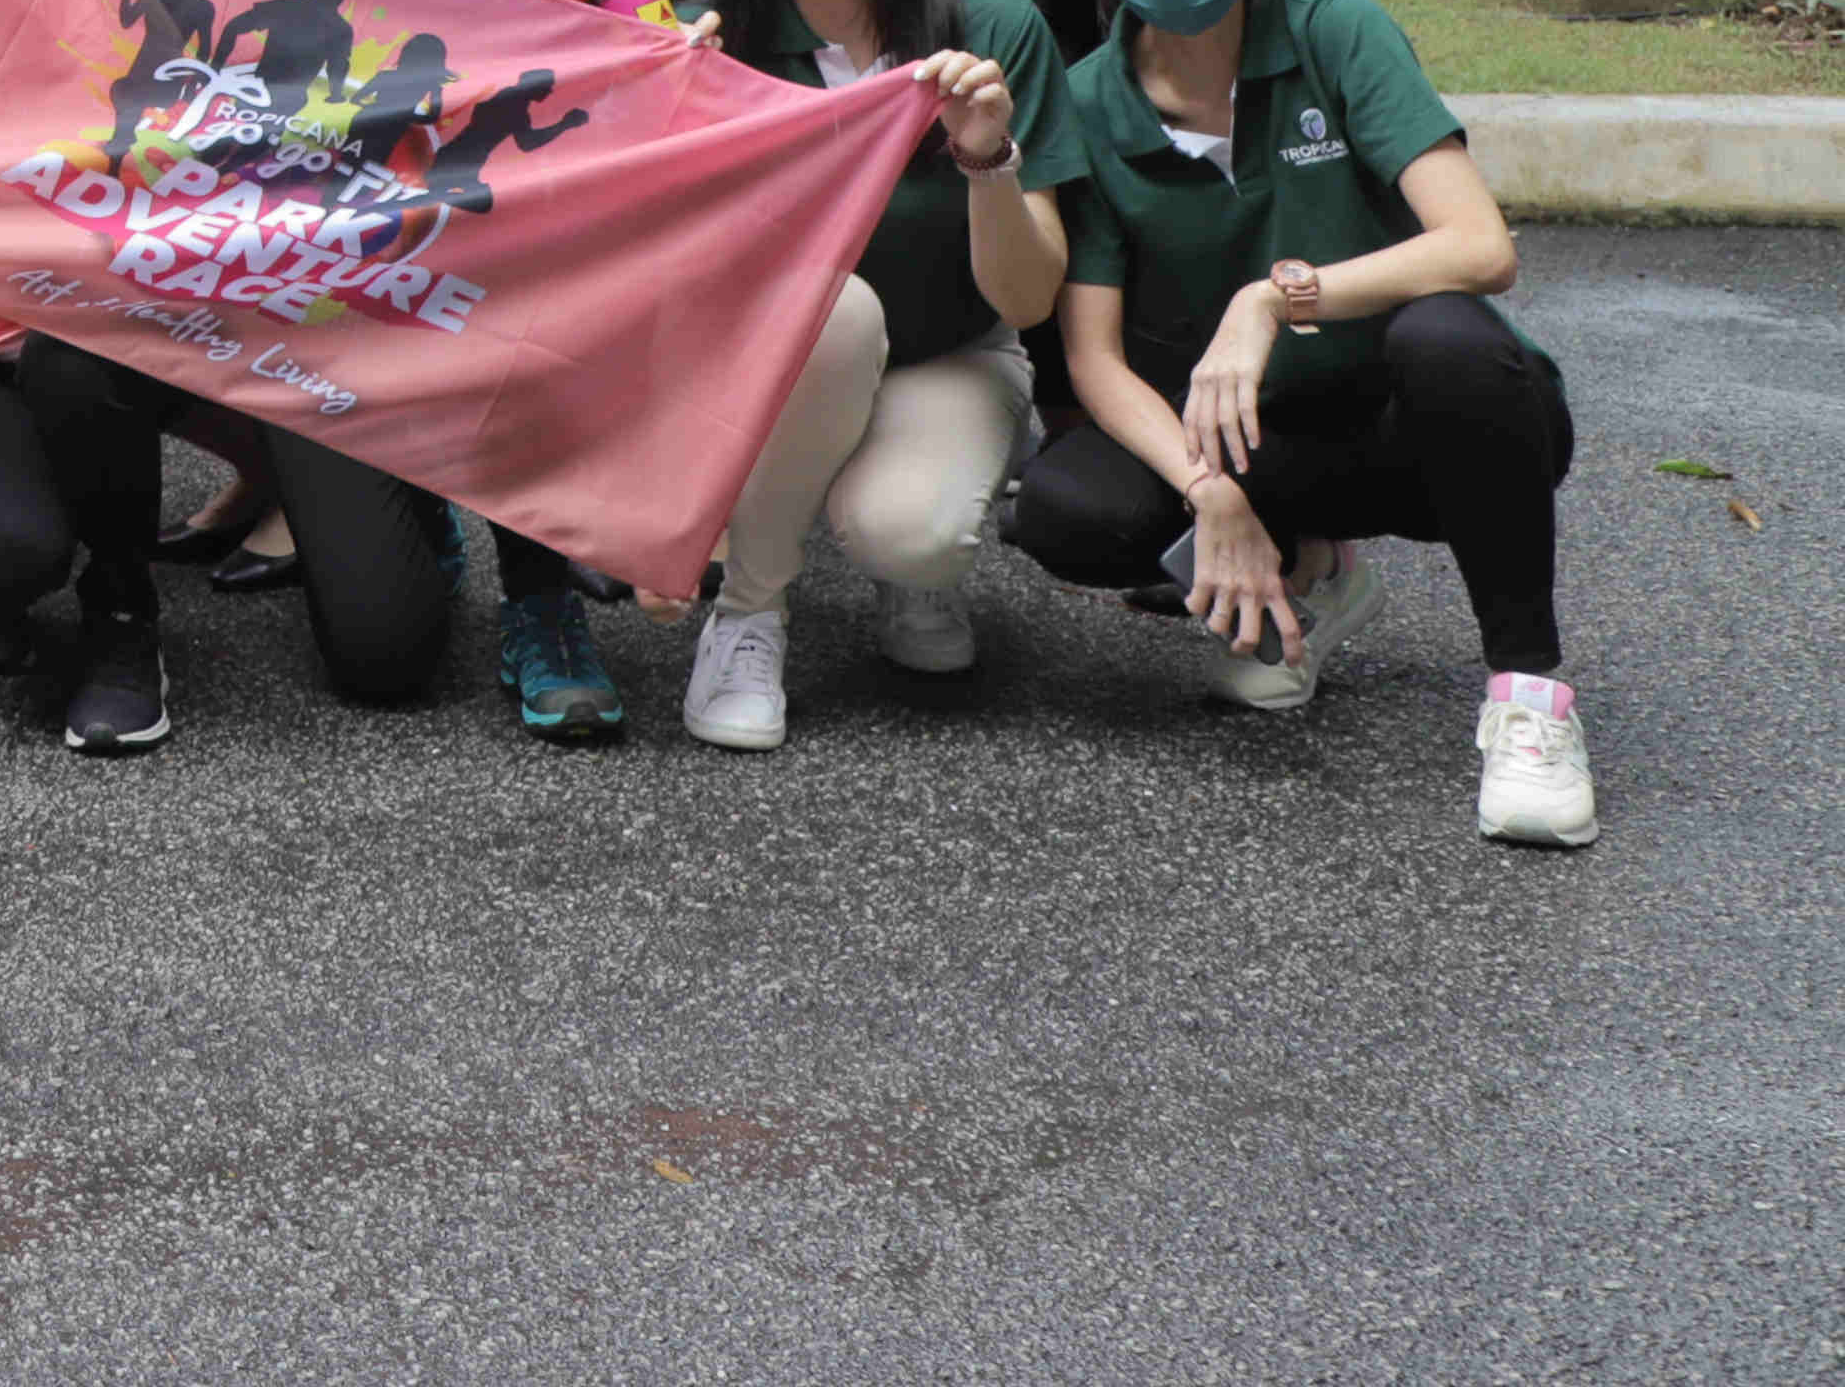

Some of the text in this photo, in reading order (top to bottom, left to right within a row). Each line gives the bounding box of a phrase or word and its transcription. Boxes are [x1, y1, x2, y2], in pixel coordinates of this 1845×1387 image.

[151, 157, 393, 259] PARK
[108, 232, 332, 326] RACE
[6, 268, 79, 306] Art
[119, 299, 246, 363] Healthy
[250, 341, 359, 415] Living
